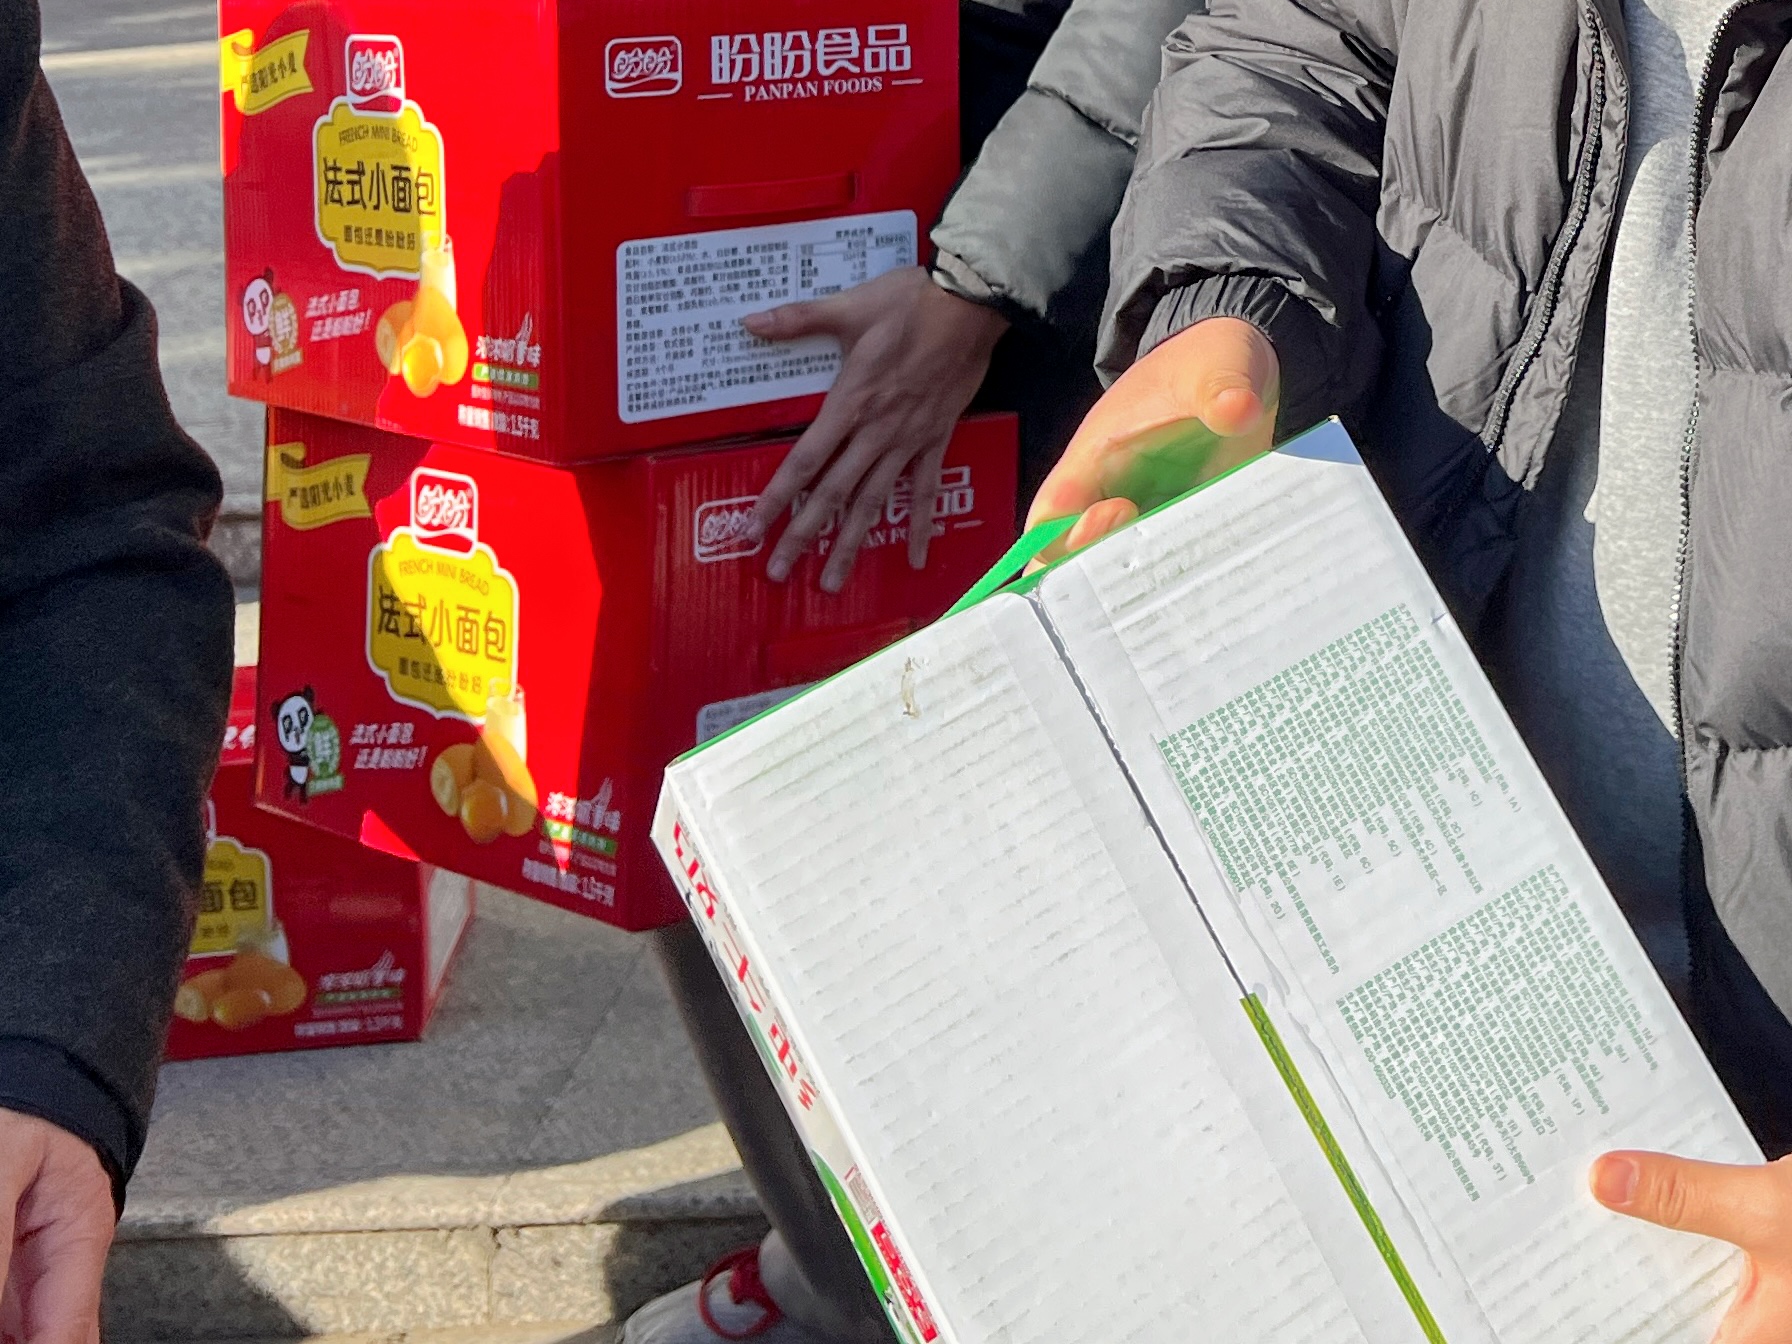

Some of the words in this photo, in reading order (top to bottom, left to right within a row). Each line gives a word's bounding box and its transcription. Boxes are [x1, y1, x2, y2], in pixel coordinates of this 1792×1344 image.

[710, 23, 912, 85] 盼盼食品
[744, 83, 819, 103] PANPAN
[824, 76, 883, 96] FOODS
[323, 157, 436, 215] 法式小面包
[399, 558, 433, 577] FRENCH
[436, 561, 457, 580] MINI
[459, 568, 489, 596] BREAD
[377, 585, 506, 663] 法式小面包
